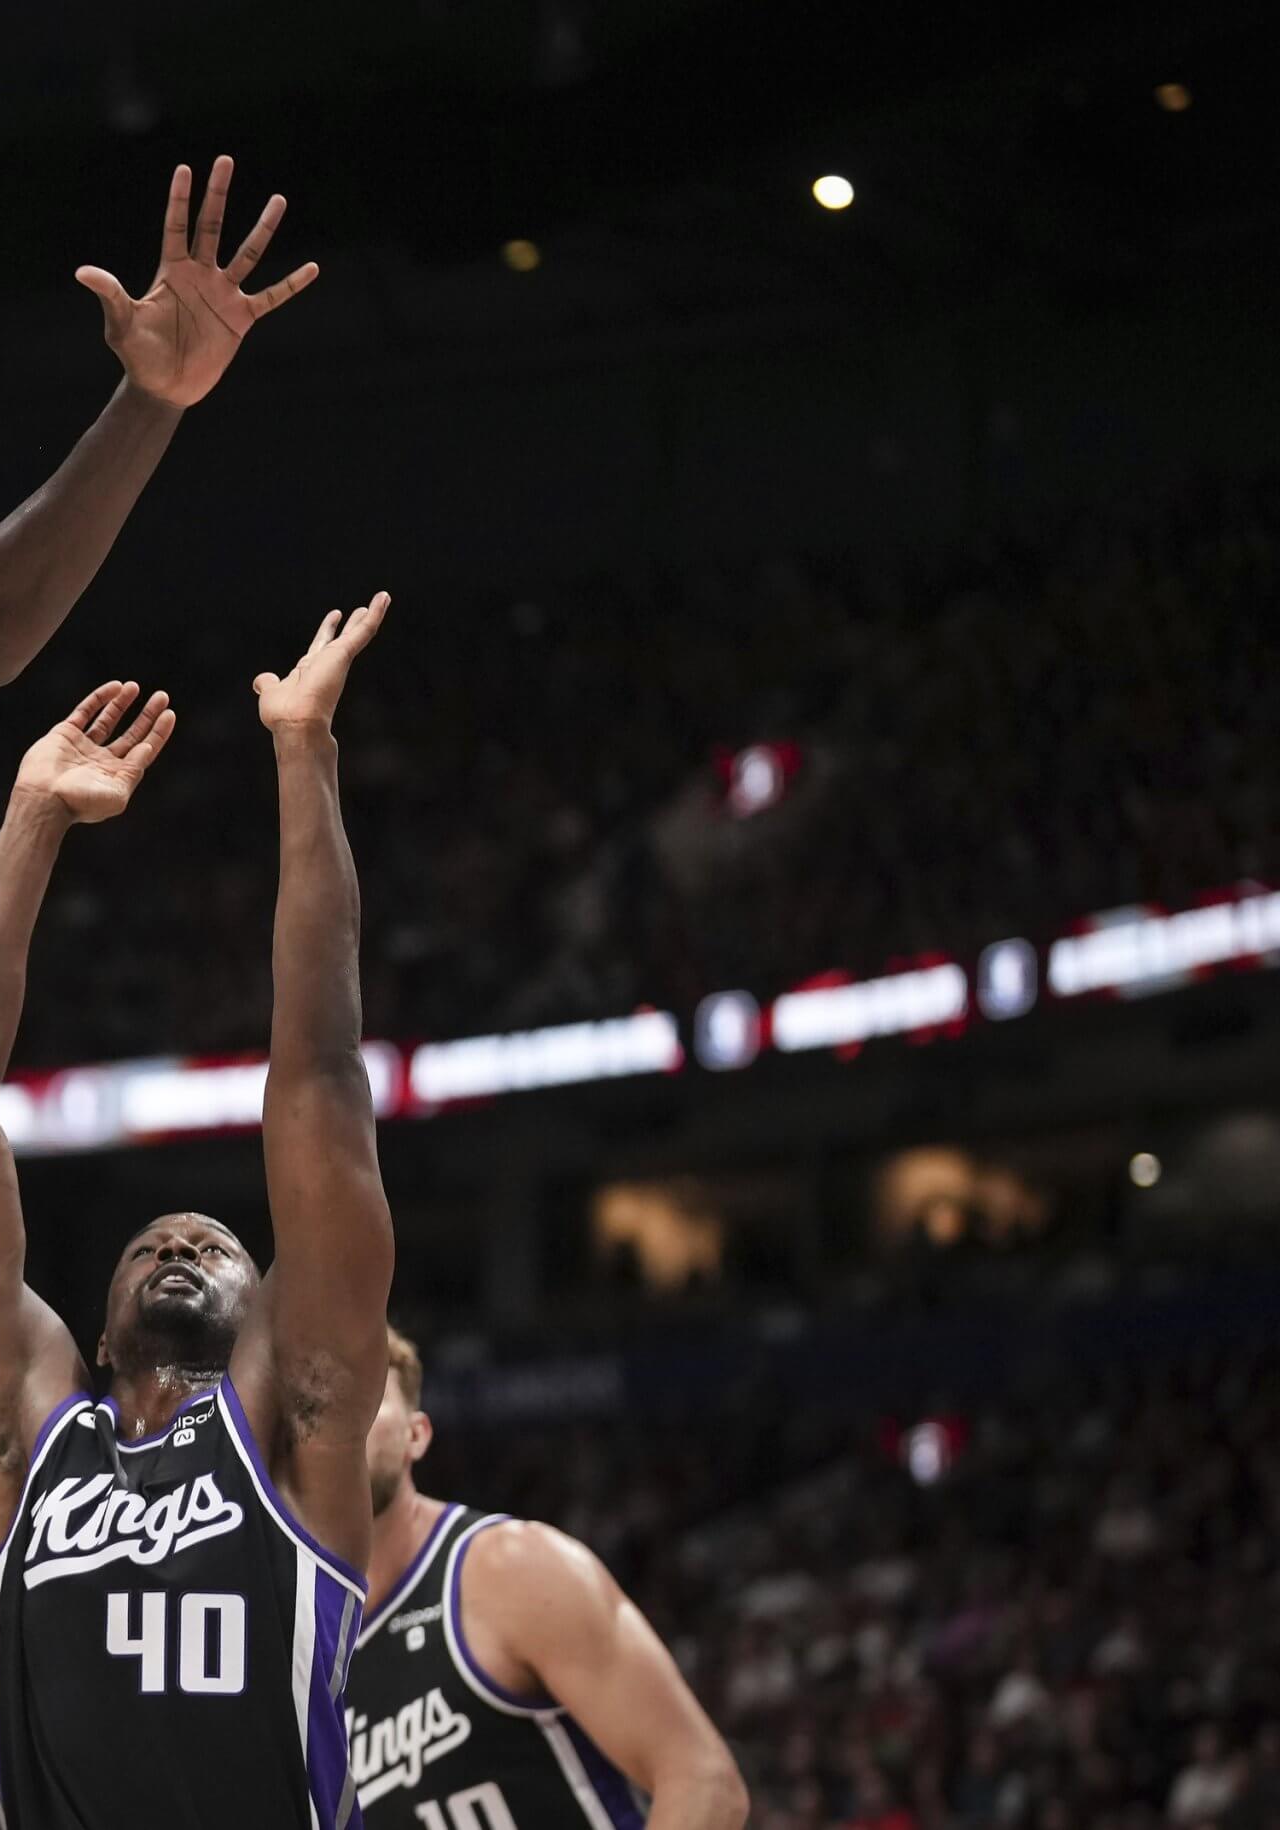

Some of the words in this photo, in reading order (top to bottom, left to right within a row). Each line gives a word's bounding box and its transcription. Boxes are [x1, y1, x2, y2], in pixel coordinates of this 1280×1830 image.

[23, 1472, 243, 1590] Kings
[106, 1592, 245, 1693] 40
[345, 1687, 471, 1811] ings
